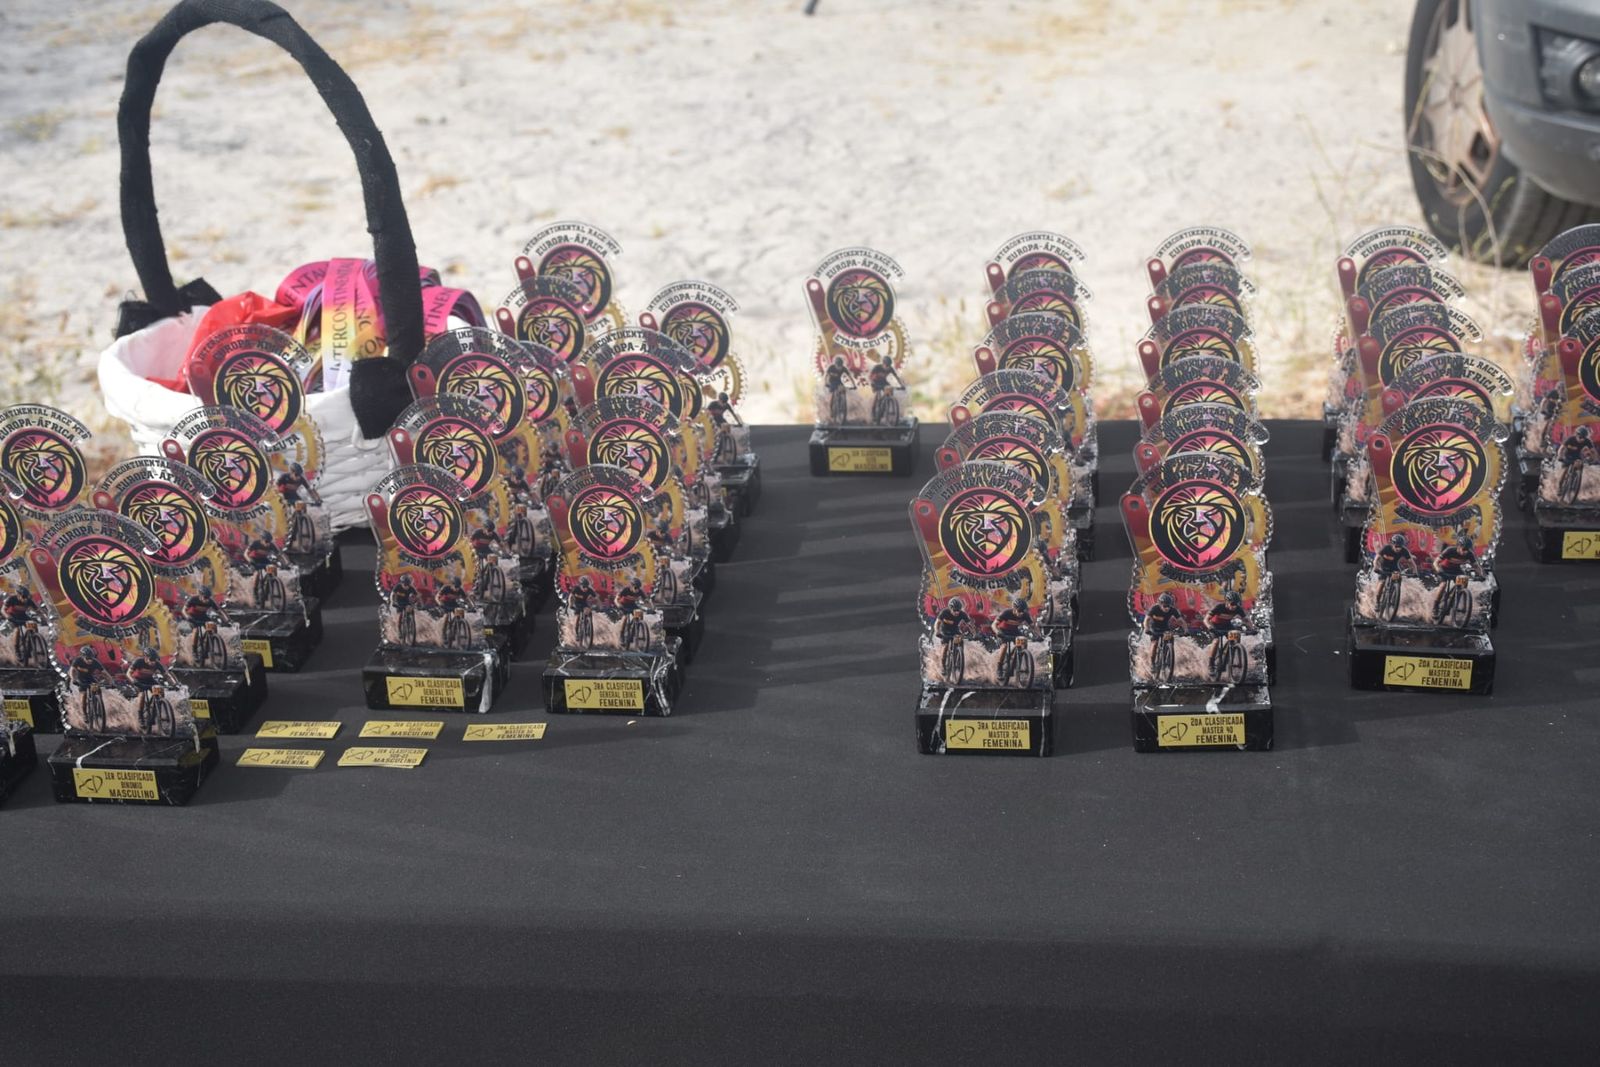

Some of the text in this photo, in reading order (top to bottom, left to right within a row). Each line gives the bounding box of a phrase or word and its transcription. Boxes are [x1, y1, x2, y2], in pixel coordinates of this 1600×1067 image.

[522, 224, 585, 255] INTERCONTINENTAL
[1156, 229, 1218, 258] INTERCONTINENTAL
[1348, 229, 1415, 258] INTERCONTINENTAL
[994, 234, 1055, 262] INTERCONTINENTAL
[814, 249, 872, 278] INTERCONTINENTAL
[647, 283, 705, 312] INTERCONTINENTAL
[51, 410, 73, 427] RACE
[1432, 660, 1471, 669] CLASIFICADA
[1428, 669, 1450, 677] MASTER
[426, 679, 460, 688] CLASIFICADA
[606, 682, 640, 691] CLASIFICADA
[1421, 677, 1463, 687] FEMENINA
[420, 696, 457, 705] FEMENINA
[599, 698, 637, 707] FEMENINA
[977, 721, 1028, 730] 3RA CLASIFICADA
[1204, 716, 1243, 726] CLASIFICADA
[1202, 726, 1224, 735] MASTER
[982, 738, 1023, 748] FEMENINA
[1196, 734, 1238, 744] FEMENINA
[116, 772, 154, 781] CLASIFICADO
[109, 789, 154, 799] MASCULINO
